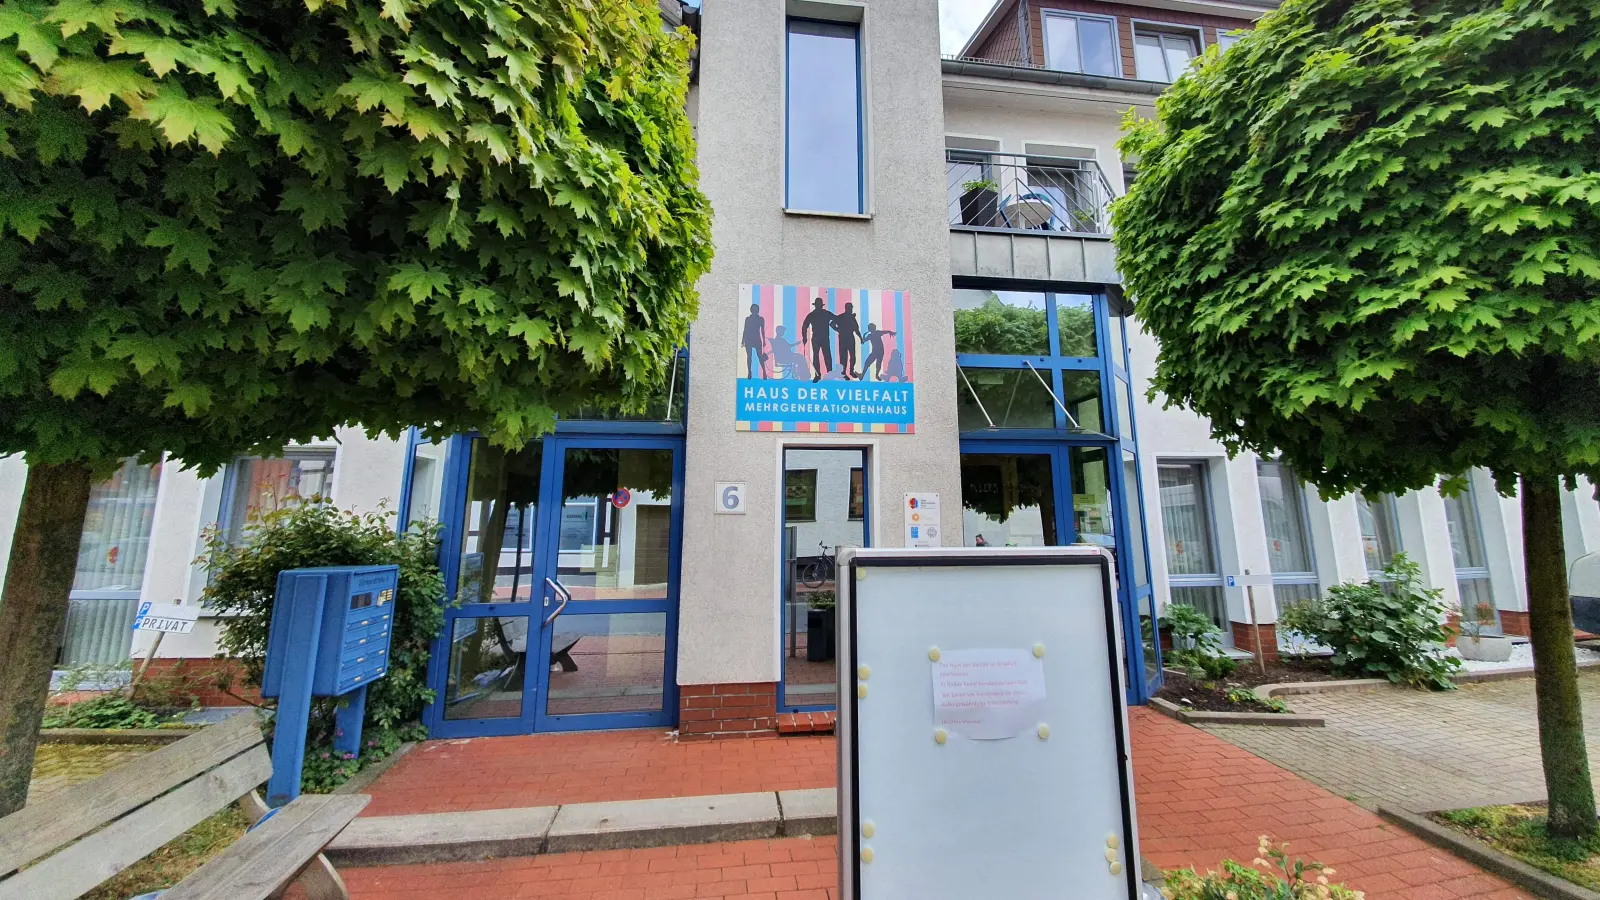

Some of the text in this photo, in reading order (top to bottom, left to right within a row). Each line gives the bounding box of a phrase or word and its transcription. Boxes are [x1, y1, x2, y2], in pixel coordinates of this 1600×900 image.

[744, 387, 908, 402] HAUS DER VIELFALT
[744, 402, 907, 415] MEHRGENERATIONENHAUS
[722, 486, 740, 509] 6
[142, 618, 188, 632] PRIVAT
